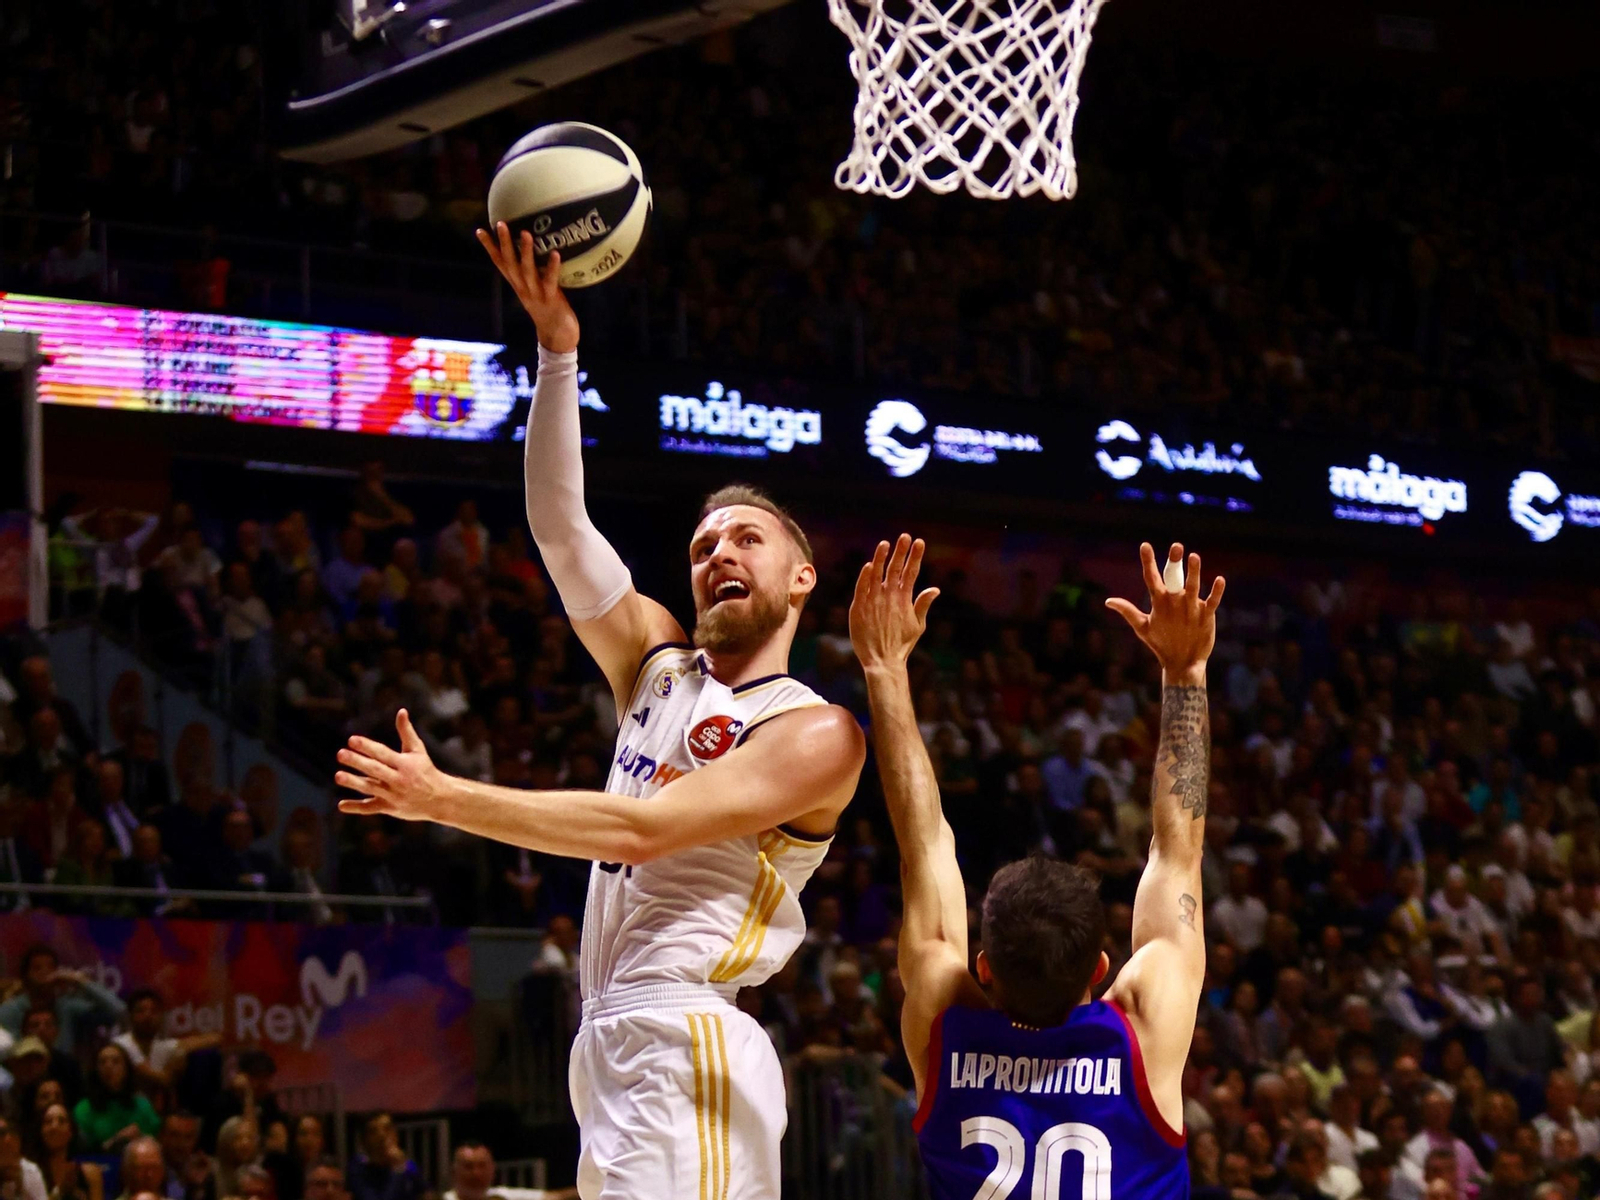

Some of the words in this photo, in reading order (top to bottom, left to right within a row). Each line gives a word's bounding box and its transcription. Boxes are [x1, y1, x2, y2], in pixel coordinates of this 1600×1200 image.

[590, 248, 623, 277] 2024
[235, 992, 324, 1052] Rey
[951, 1052, 1122, 1096] LAPROVITTOLA
